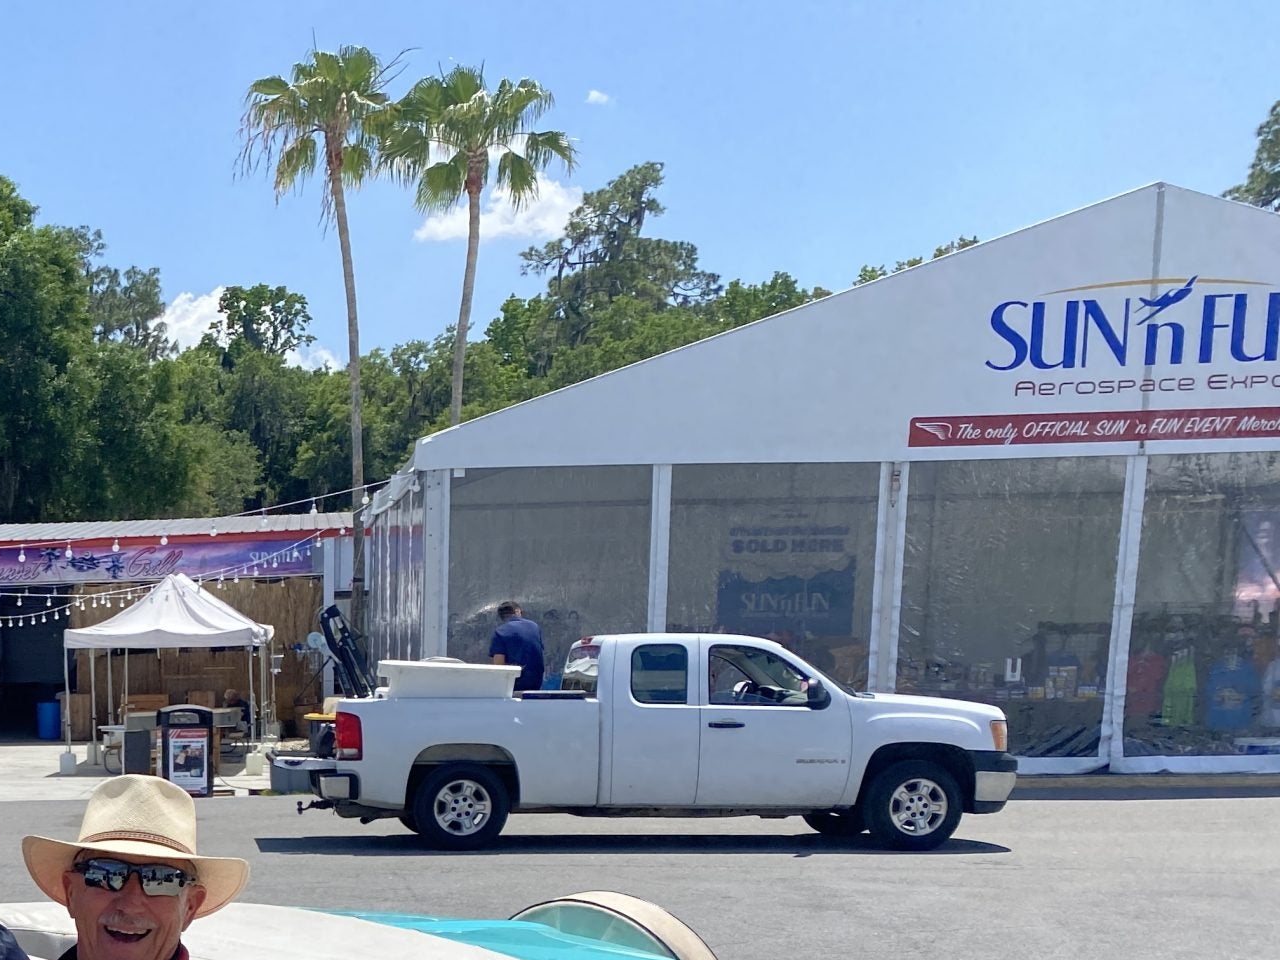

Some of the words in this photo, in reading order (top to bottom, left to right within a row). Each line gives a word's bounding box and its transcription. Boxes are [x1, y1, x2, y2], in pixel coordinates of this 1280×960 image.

[985, 298, 1131, 371] SUN
[1014, 377, 1196, 397] Aerospace
[956, 423, 981, 440] The
[984, 422, 1017, 445] only
[1022, 420, 1089, 438] OFFICIAL
[1093, 418, 1131, 436] SUN
[1150, 417, 1184, 434] FUN
[1184, 415, 1237, 433] EVENT
[731, 538, 787, 553] SOLD
[791, 538, 845, 553] HERE
[126, 546, 184, 577] Grill
